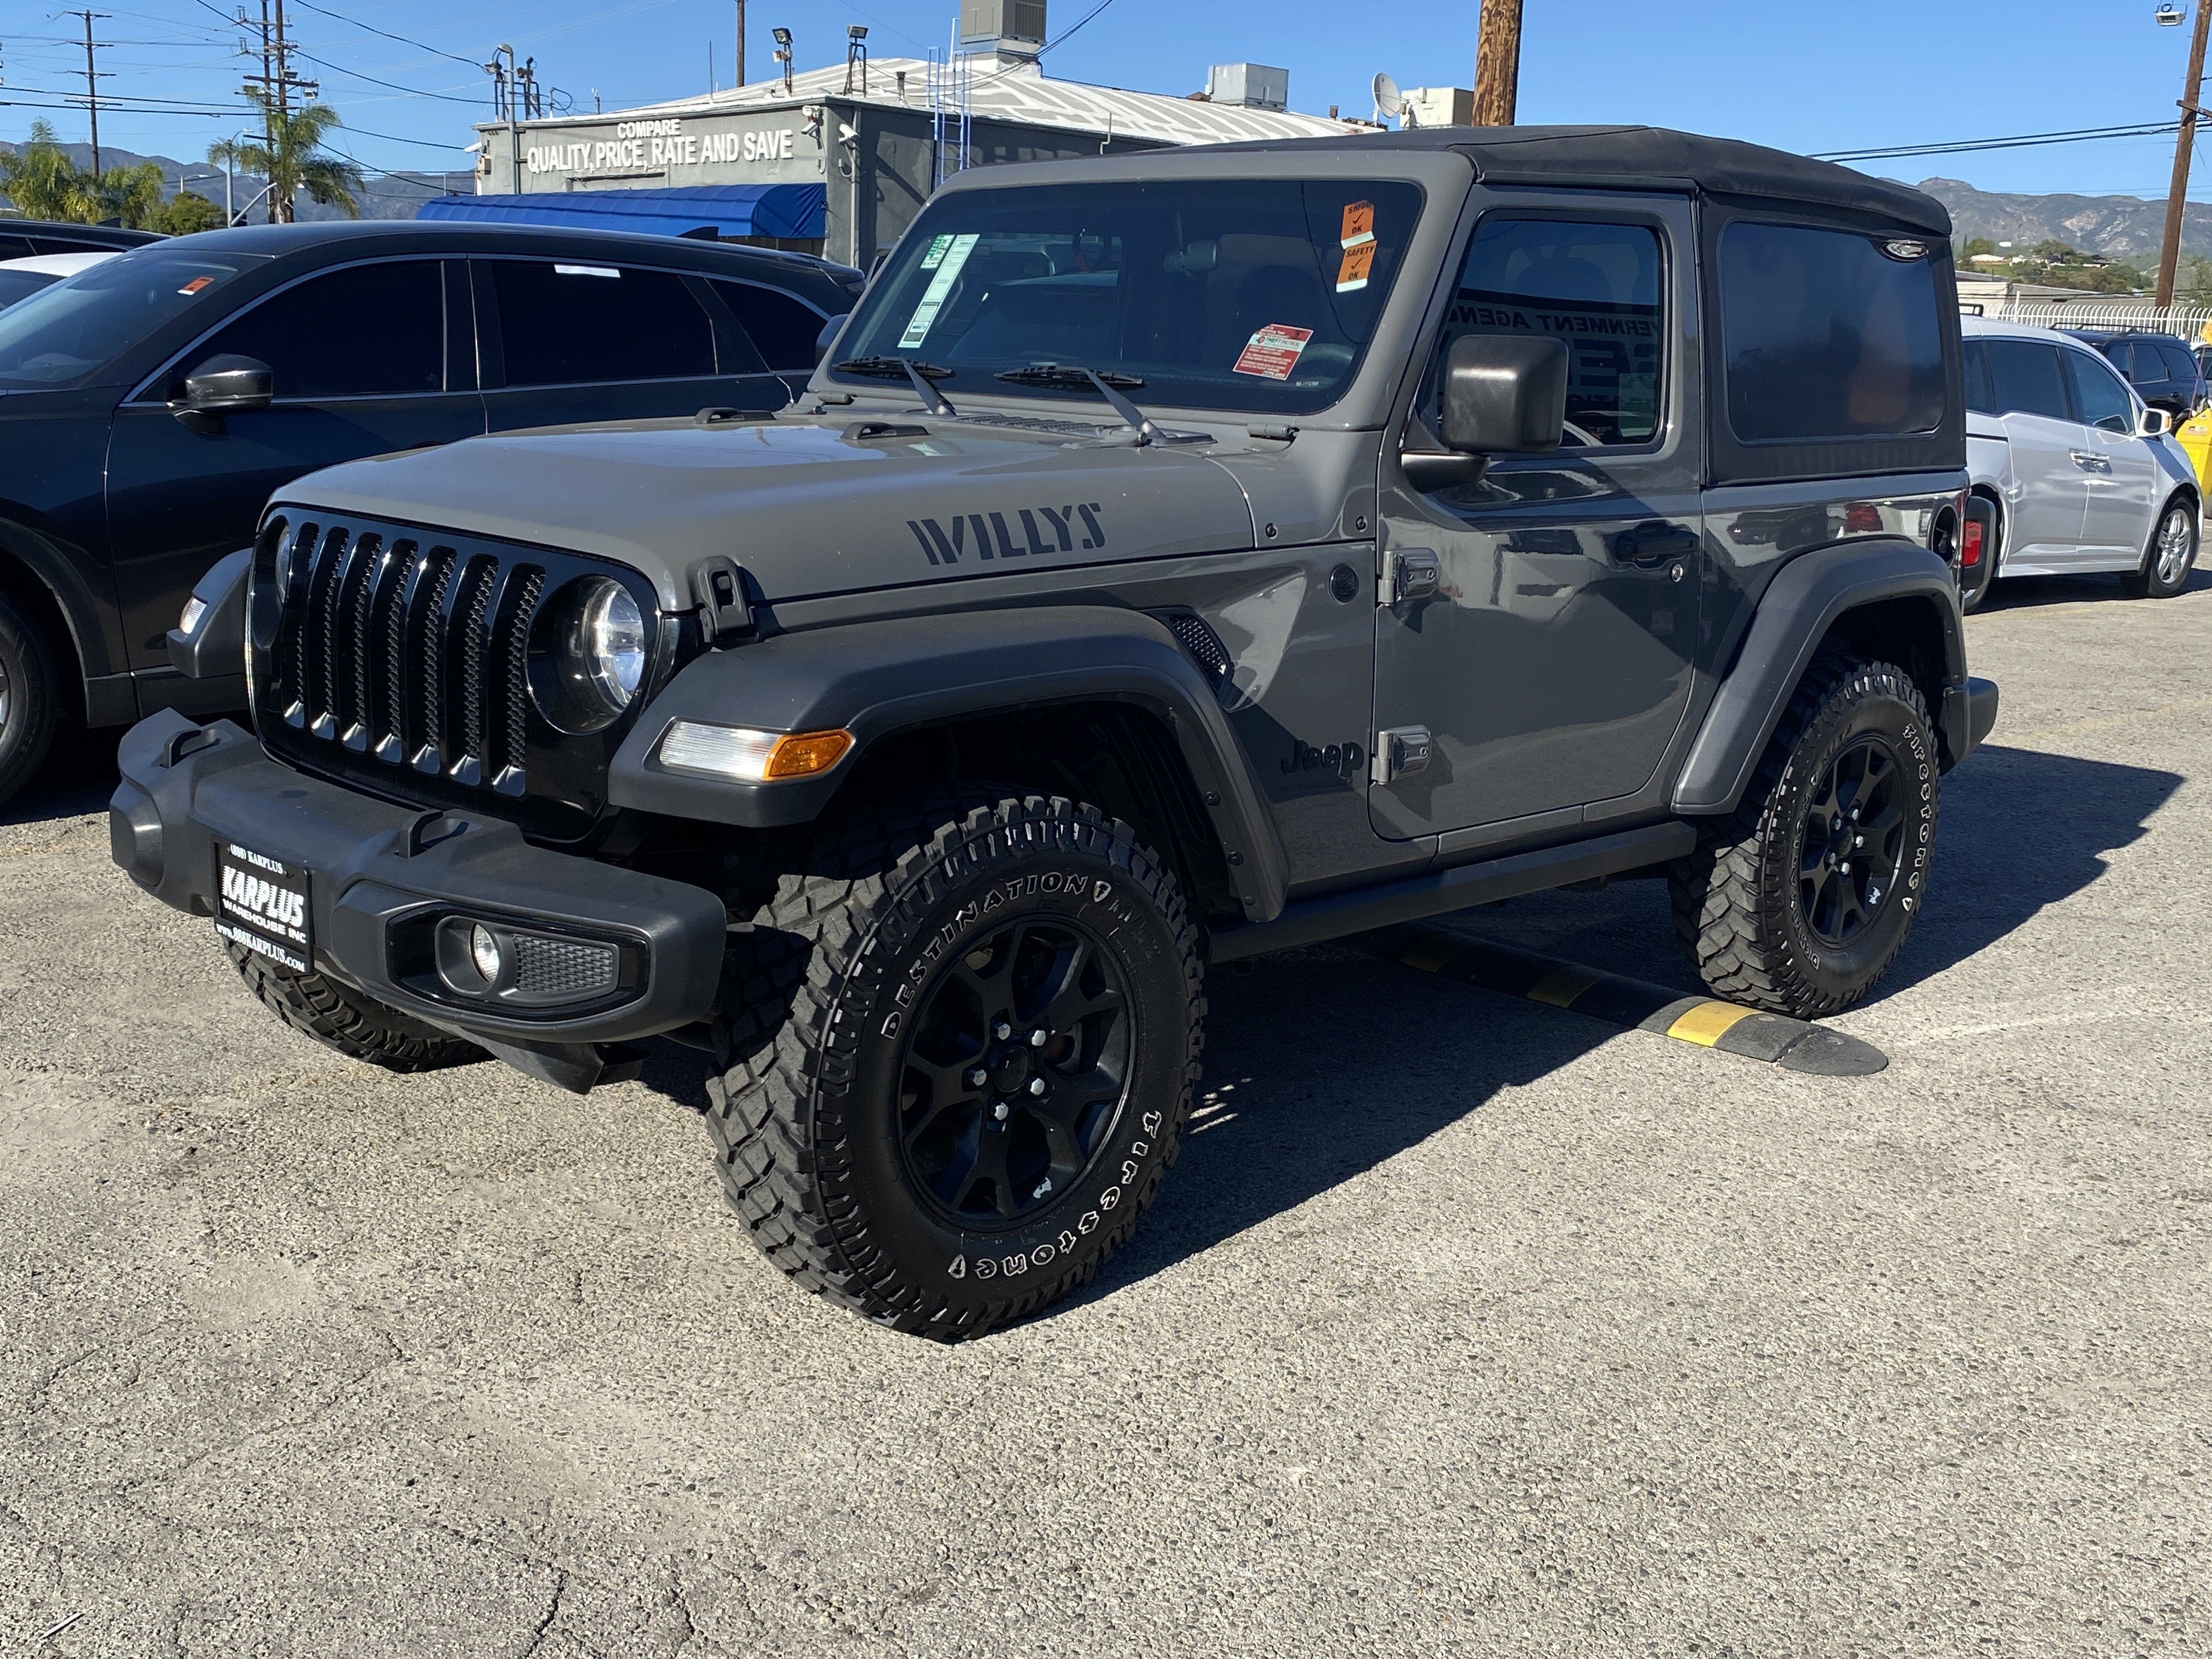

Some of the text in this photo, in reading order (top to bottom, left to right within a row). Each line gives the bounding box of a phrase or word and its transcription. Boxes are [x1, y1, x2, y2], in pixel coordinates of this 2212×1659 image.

[617, 119, 681, 139] COMPARE
[527, 129, 793, 173] QUALITY, PRICE, RATE AND SAVE
[1352, 225, 1362, 234] OK
[1346, 245, 1374, 257] SAFETY
[1348, 272, 1359, 280] OK
[1279, 338, 1300, 347] PATROL
[906, 503, 1105, 565] WILLYS
[1281, 740, 1364, 778] Jeep
[247, 850, 284, 874] KARPLUS
[222, 865, 304, 927] KARPLUS
[222, 898, 307, 944] WAREHOUSE INC
[881, 871, 1088, 1039] DESTINATION
